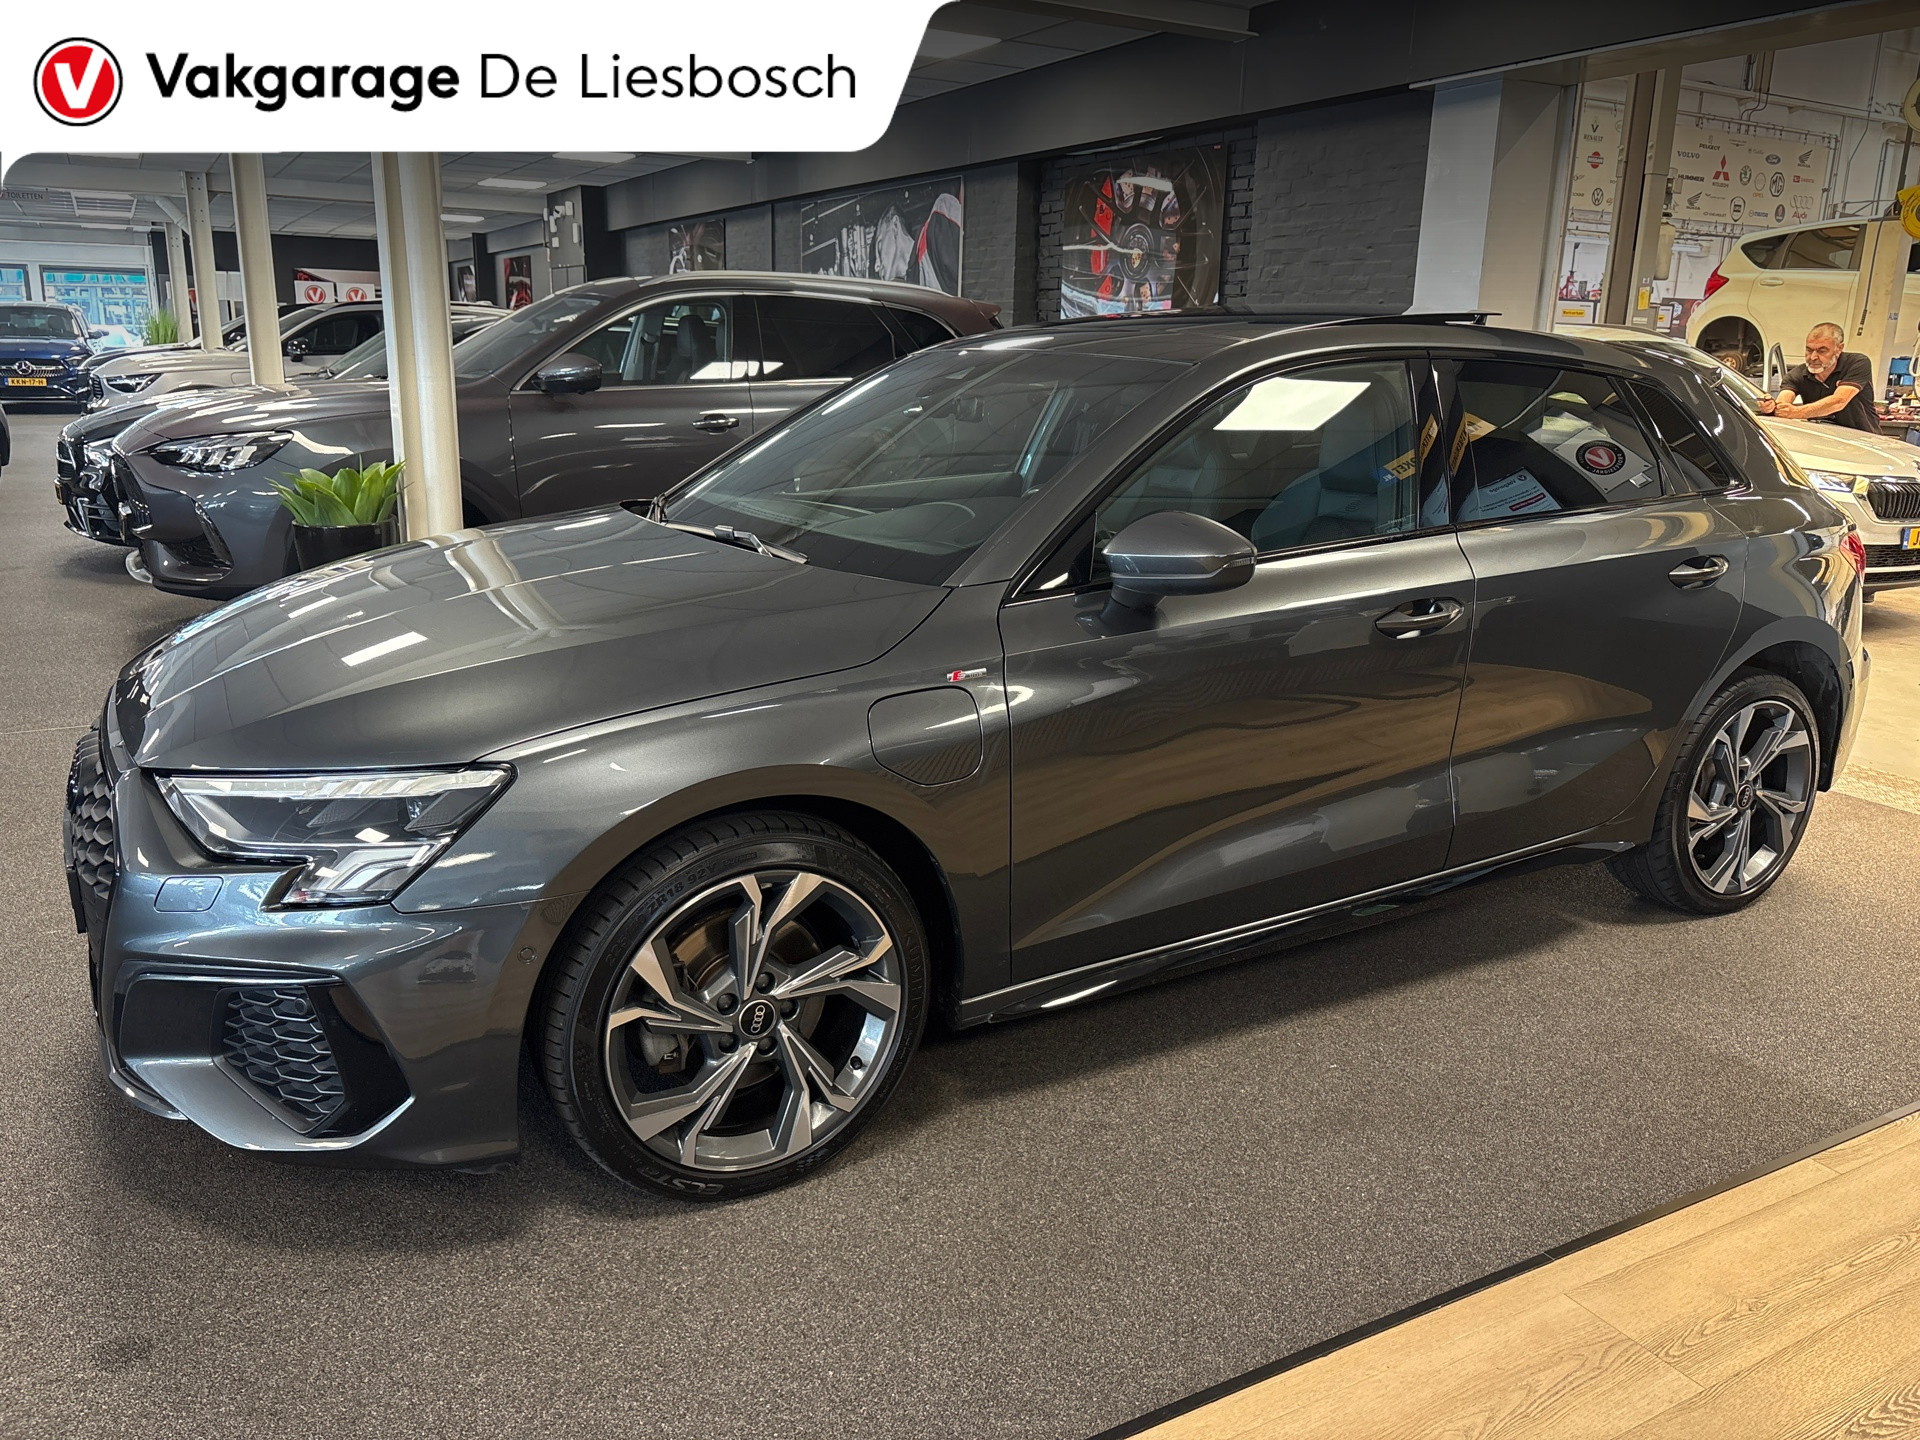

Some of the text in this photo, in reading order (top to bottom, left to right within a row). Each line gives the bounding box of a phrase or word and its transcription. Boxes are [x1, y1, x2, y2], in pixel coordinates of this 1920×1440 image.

[1677, 151, 1701, 159] VOLVO
[1678, 174, 1705, 182] HUMMER
[6, 191, 43, 200] TOILETTEN
